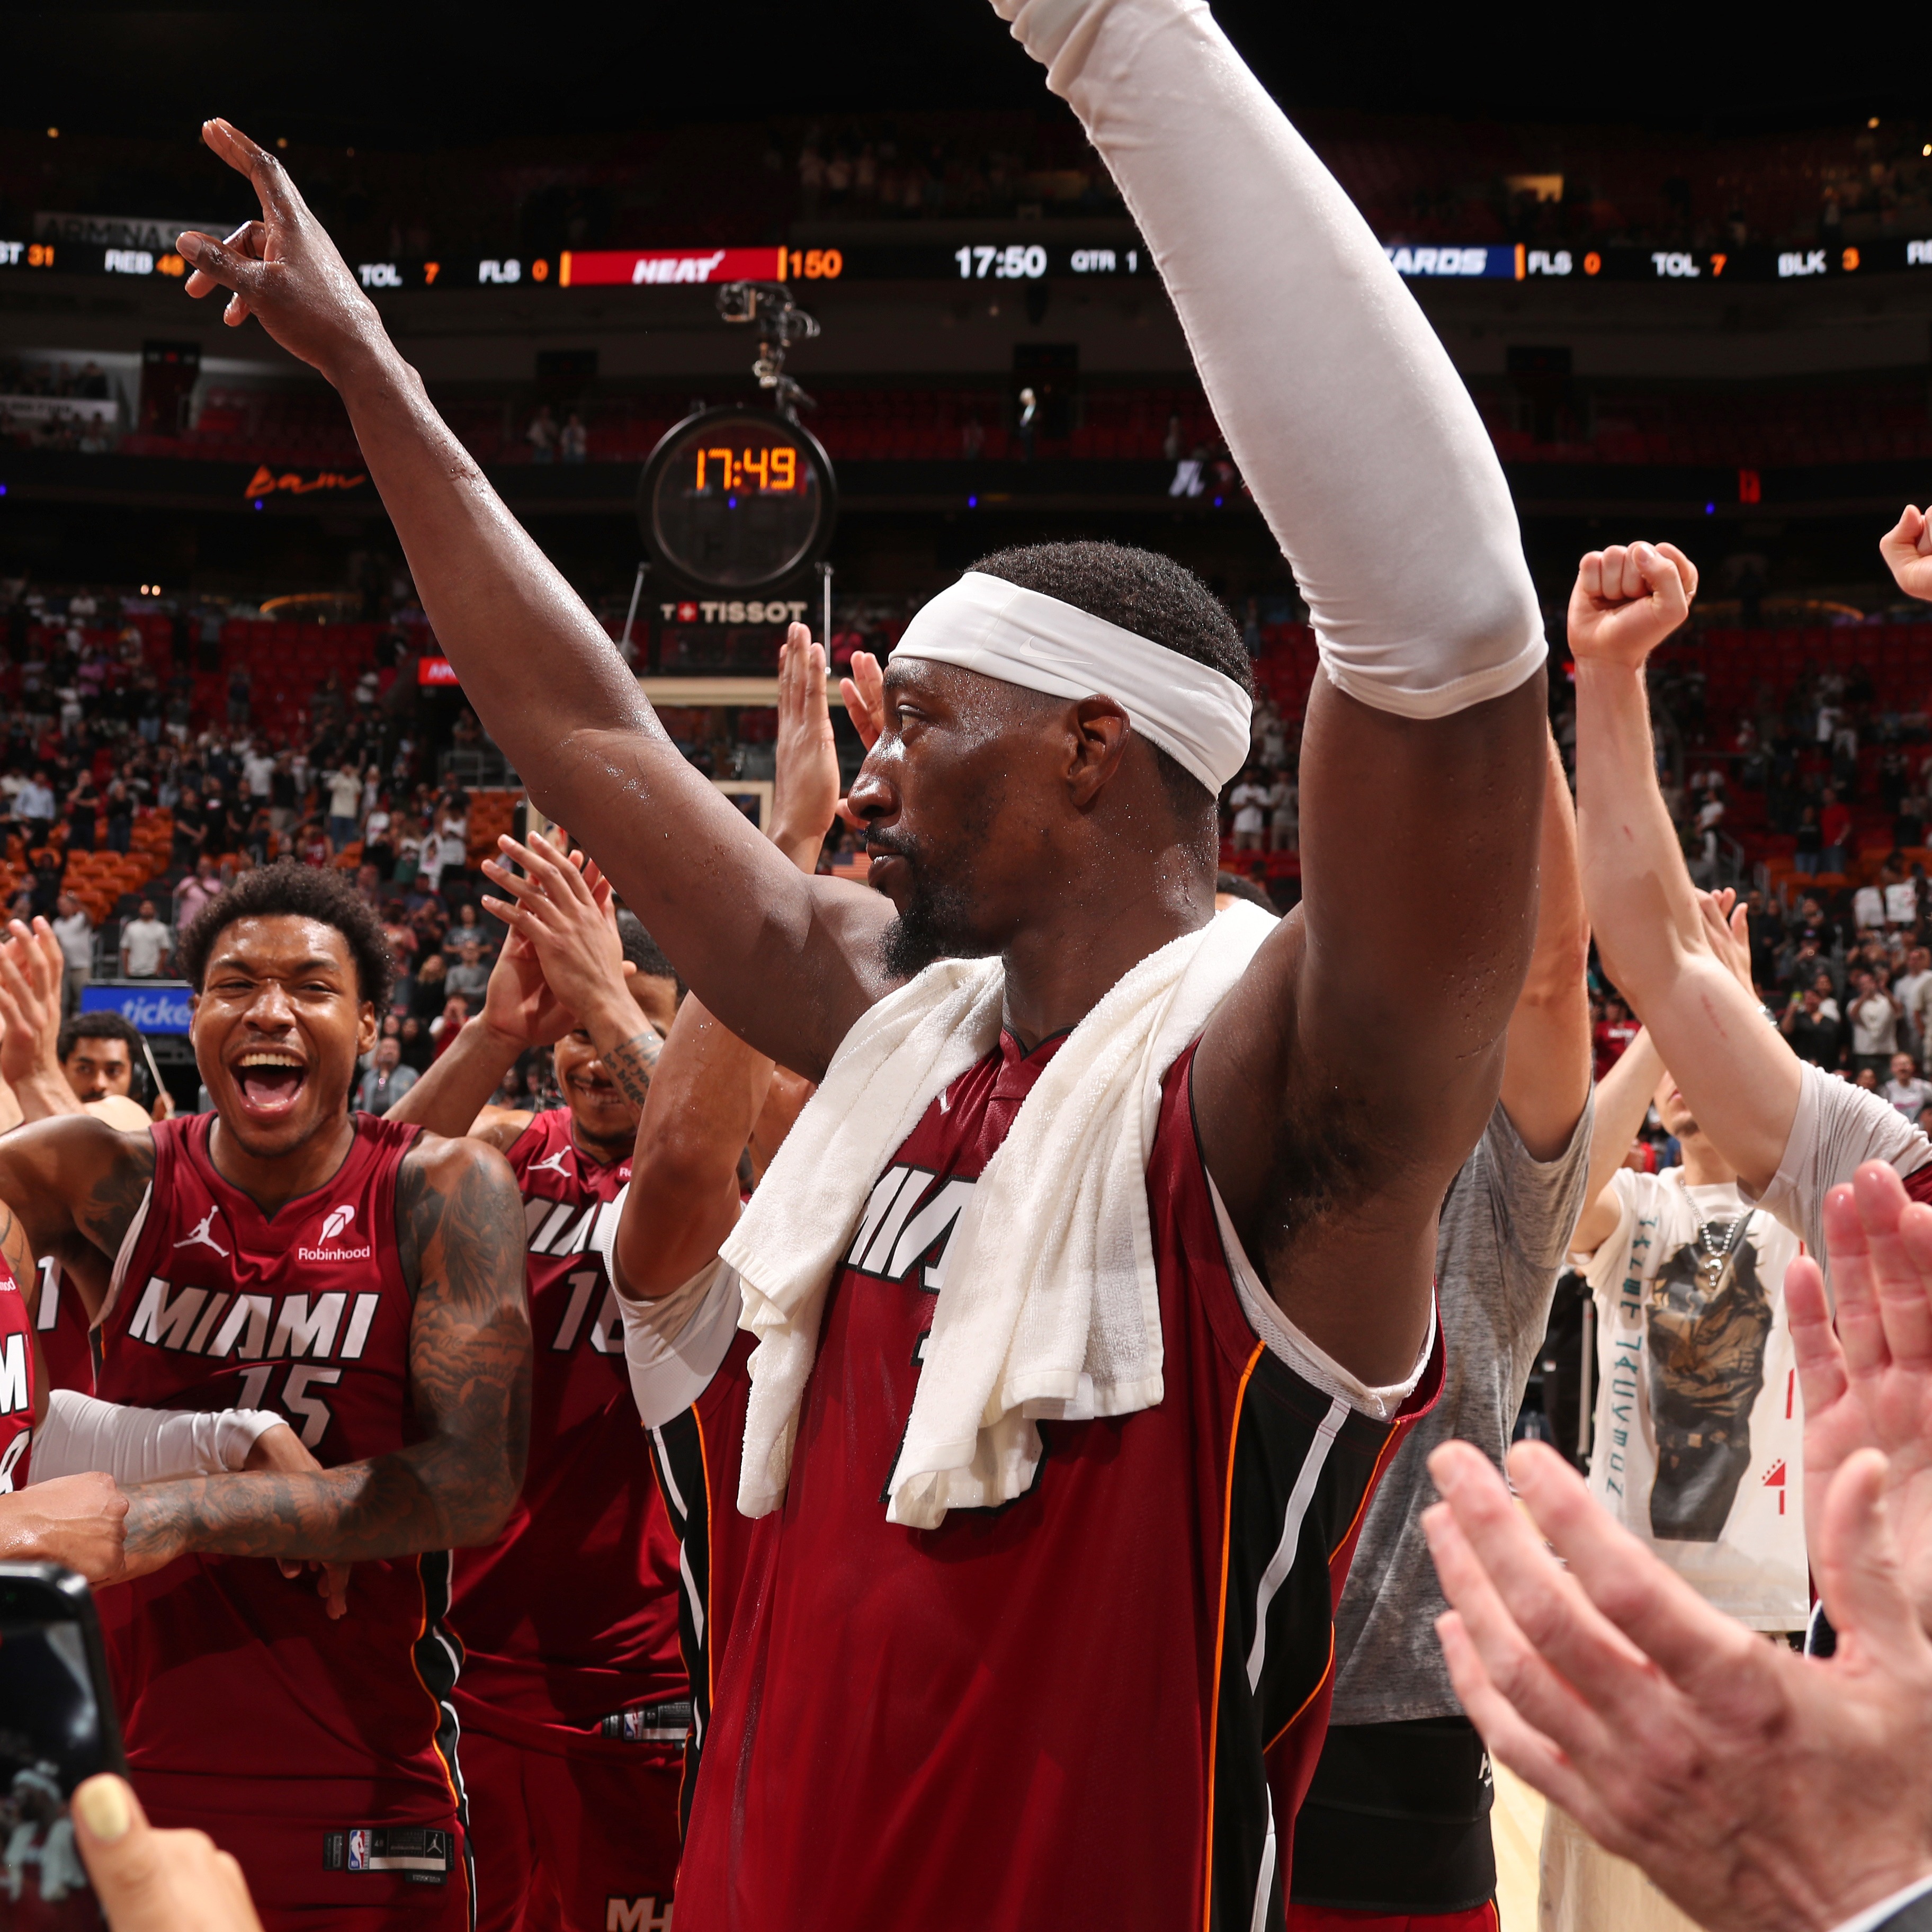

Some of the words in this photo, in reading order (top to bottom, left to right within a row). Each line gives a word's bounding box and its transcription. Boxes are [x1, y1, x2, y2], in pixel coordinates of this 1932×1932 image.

[358, 264, 402, 287] TOL
[424, 262, 440, 285] 7
[479, 258, 521, 283] FLS
[531, 259, 548, 282] 0
[632, 250, 726, 284] HEAT
[790, 249, 843, 279] 150
[955, 245, 1046, 278] 17:50
[1071, 249, 1116, 273] QTR
[1125, 249, 1137, 273] 1
[1383, 247, 1487, 275] ARDS
[1528, 250, 1572, 275] FLS
[1584, 251, 1601, 276] 0
[1651, 252, 1700, 277] TOL
[1710, 253, 1727, 278] 7
[1778, 249, 1827, 277] BLK
[696, 447, 796, 490] 17:49
[699, 601, 808, 623] TISSOT
[298, 1245, 370, 1260] Robinhood
[127, 1275, 380, 1360] MIAMI
